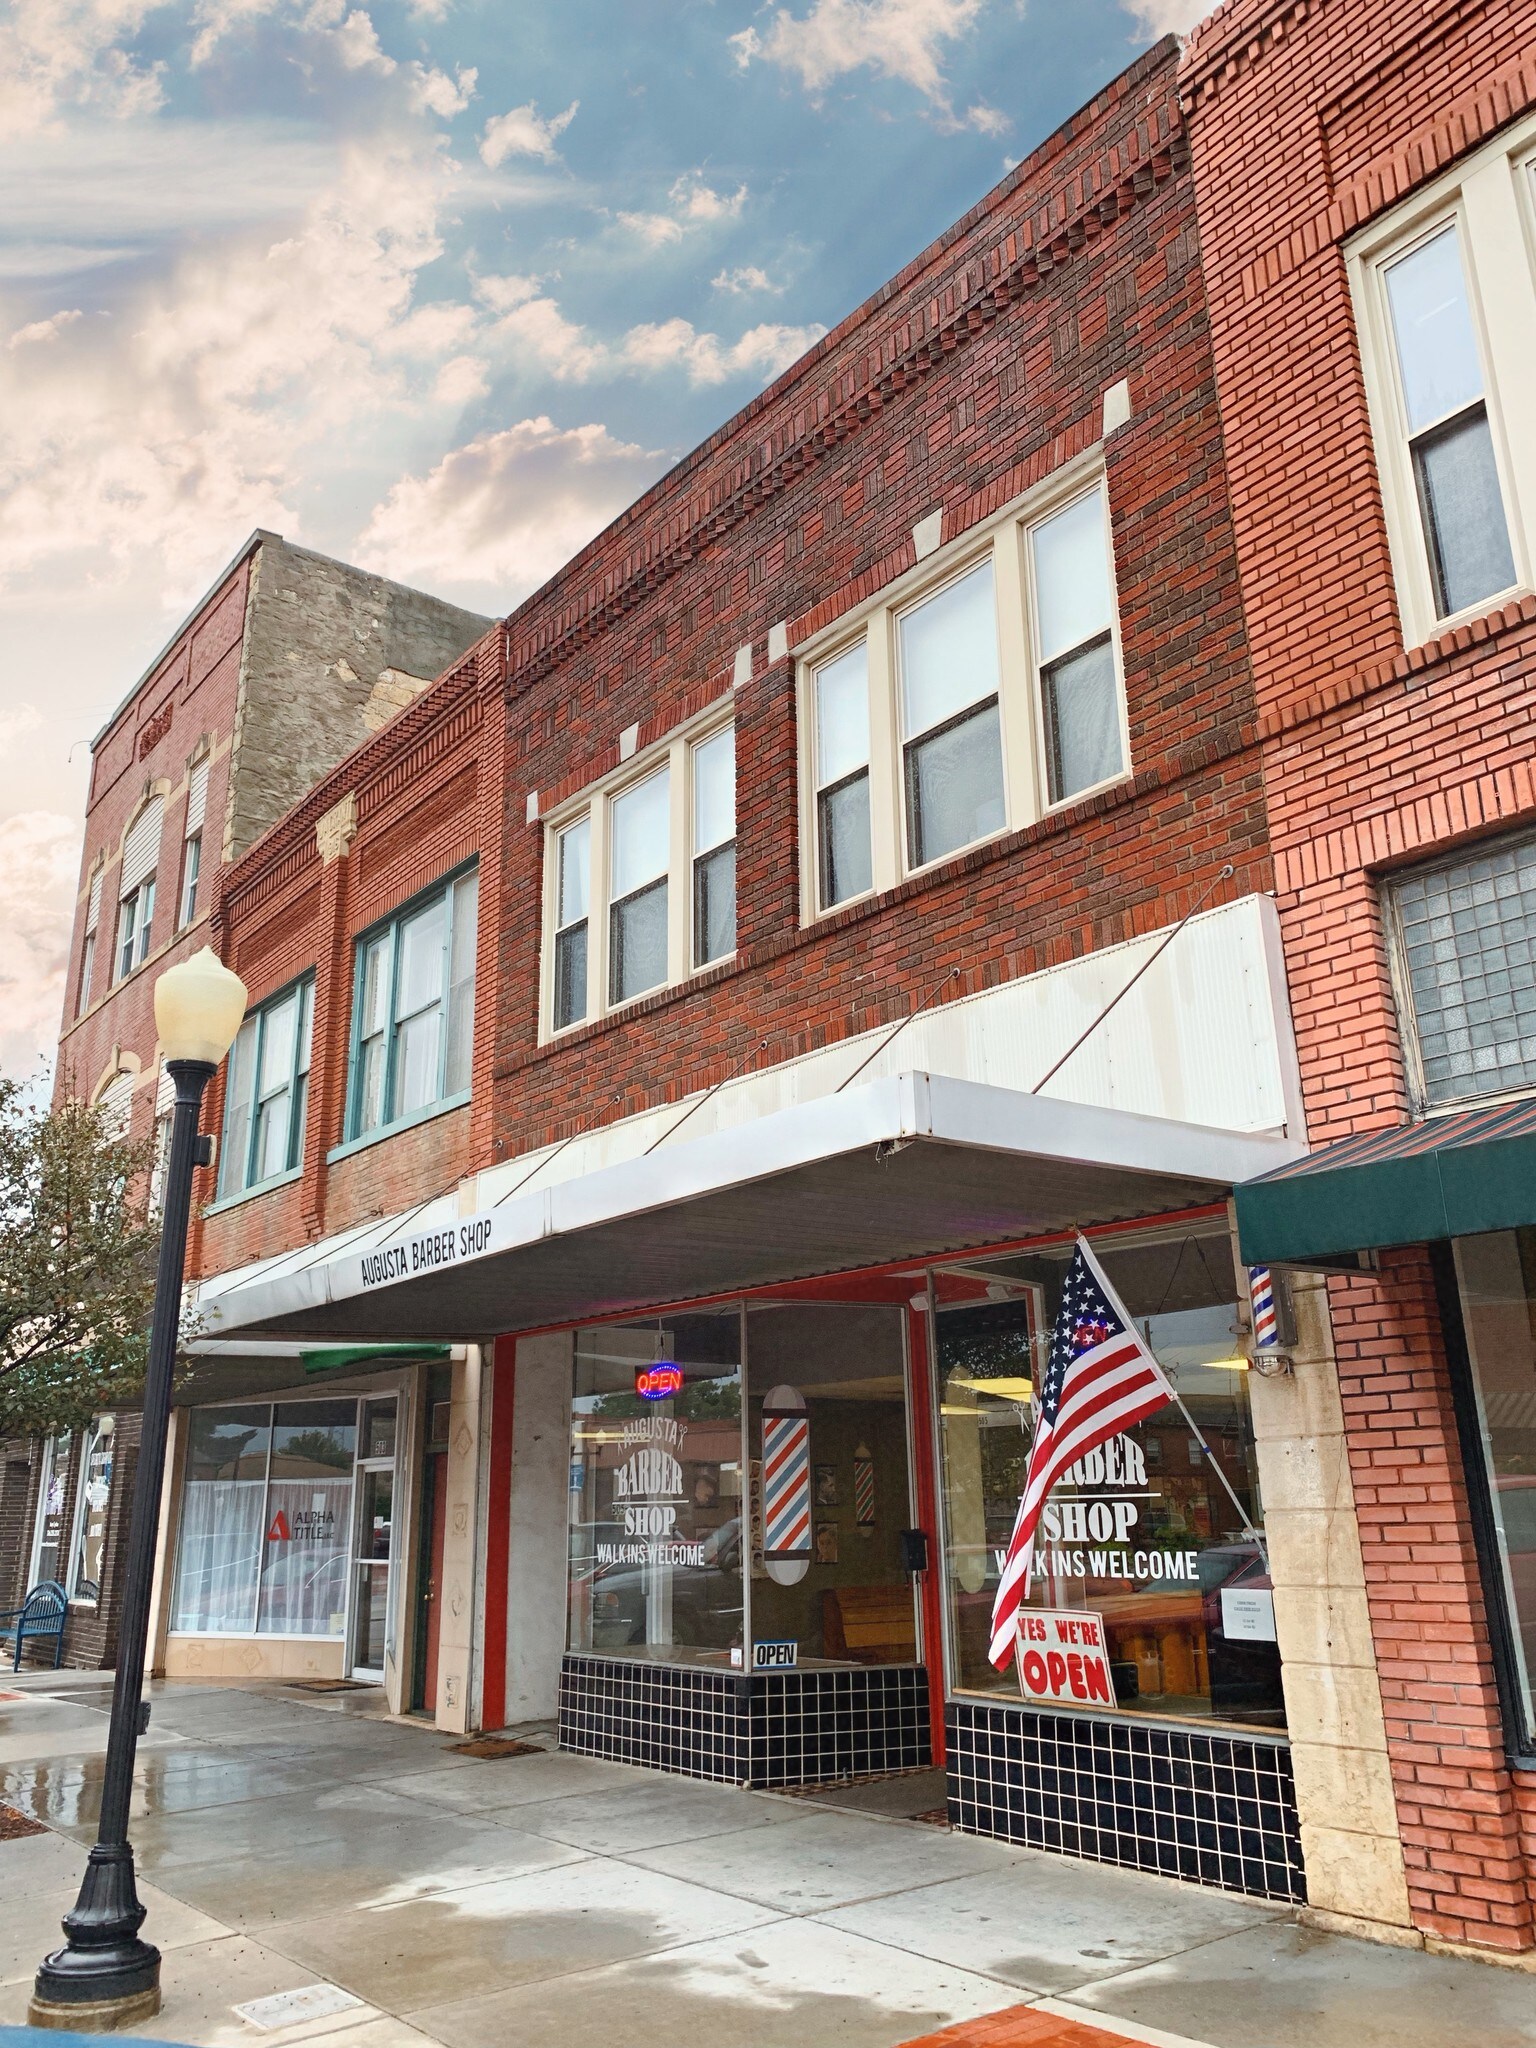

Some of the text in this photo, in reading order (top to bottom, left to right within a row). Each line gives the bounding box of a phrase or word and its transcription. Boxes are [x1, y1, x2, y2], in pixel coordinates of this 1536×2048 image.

[361, 1219, 492, 1287] AUGUSTA BARBER SHOP
[637, 1372, 681, 1393] OPEN
[623, 1416, 678, 1449] AUGUSTA
[616, 1448, 684, 1497] BARBER
[294, 1510, 335, 1524] ALPHA
[624, 1507, 676, 1536] SHOP
[1042, 1502, 1138, 1543] SHOP
[294, 1527, 323, 1540] TITLE
[647, 1544, 706, 1566] WELCOME
[1052, 1550, 1086, 1578] INS
[1088, 1551, 1200, 1580] WELCOME
[1018, 1617, 1100, 1647] YES WE'RE
[757, 1644, 794, 1666] OPEN
[1022, 1649, 1110, 1704] OPEN
